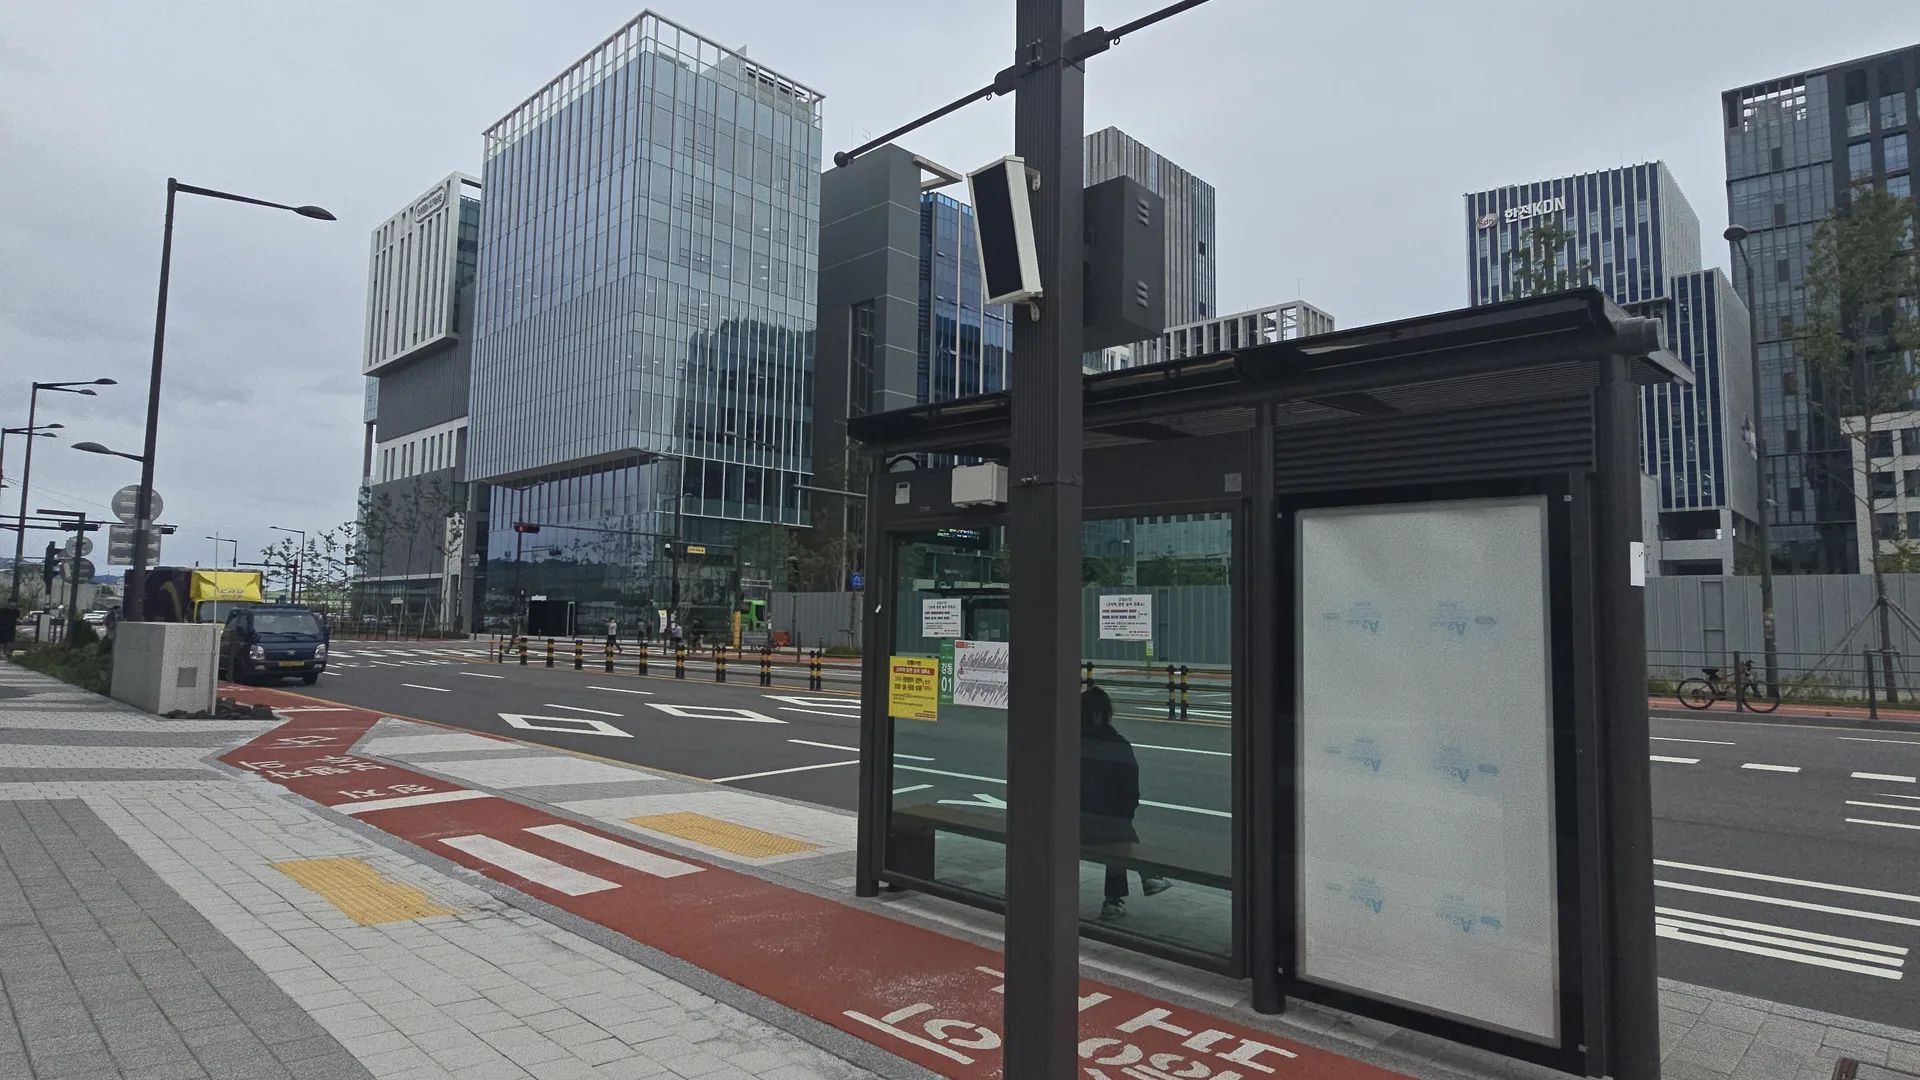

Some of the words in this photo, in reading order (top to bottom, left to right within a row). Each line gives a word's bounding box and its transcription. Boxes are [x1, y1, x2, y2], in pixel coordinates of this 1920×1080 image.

[1504, 196, 1566, 224] 한전KDN
[941, 663, 953, 675] 강동
[941, 676, 953, 693] 01
